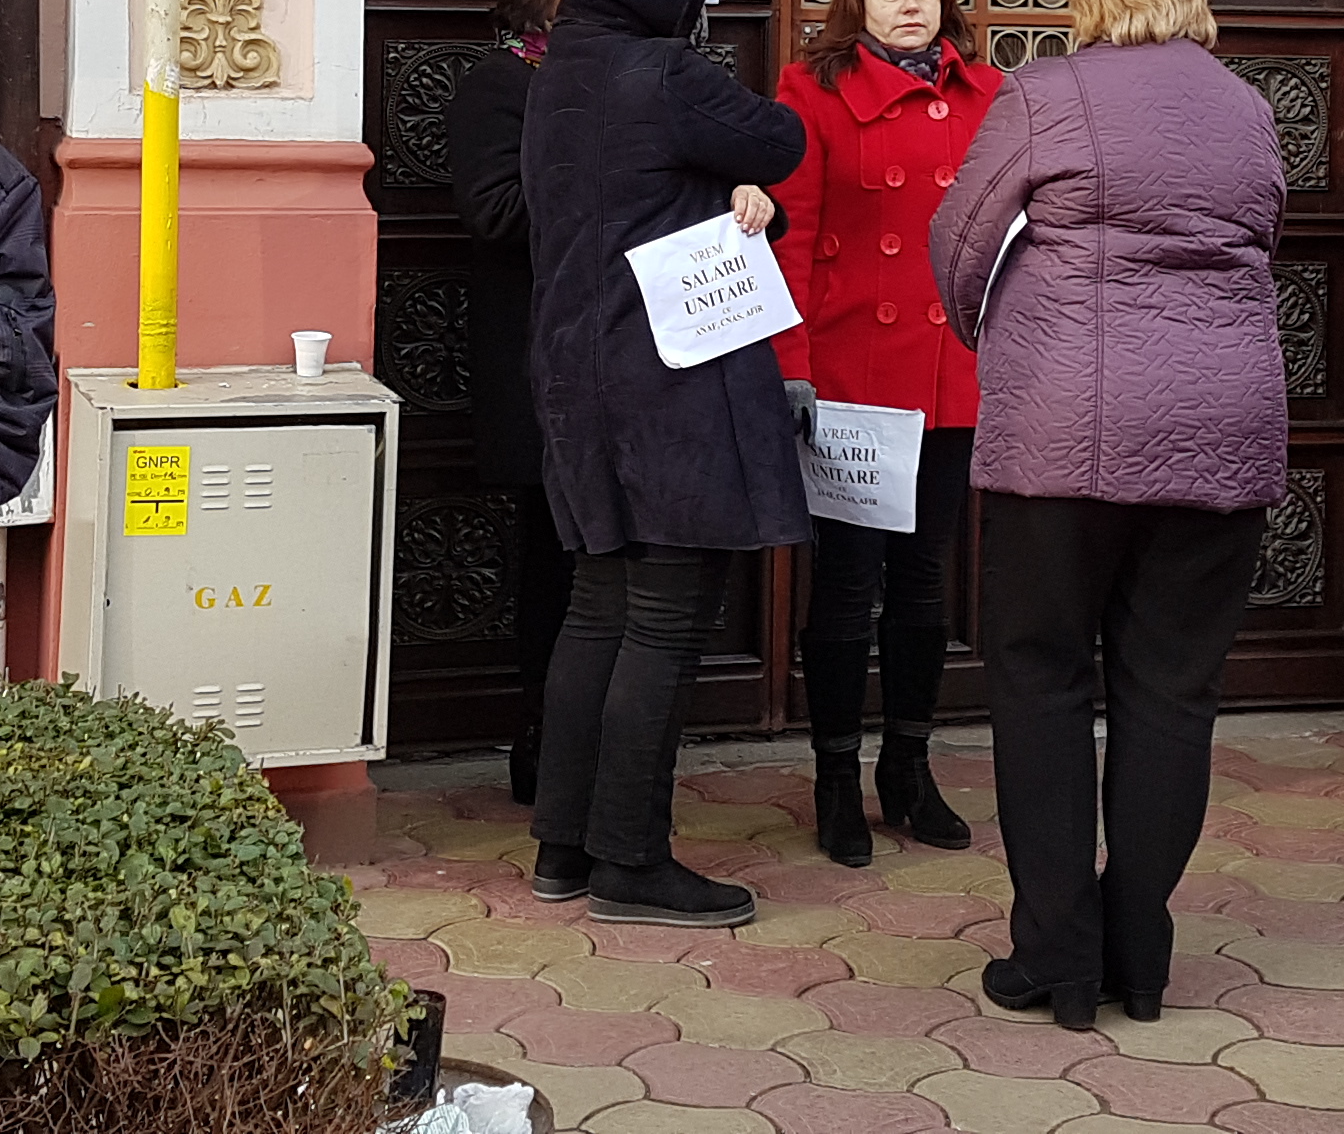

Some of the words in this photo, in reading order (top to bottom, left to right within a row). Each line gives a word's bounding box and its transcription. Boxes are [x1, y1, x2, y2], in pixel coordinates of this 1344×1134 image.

[689, 242, 724, 263] VREM
[681, 254, 747, 292] SALARII
[684, 275, 758, 315] UNITARE
[821, 428, 859, 441] VREM
[136, 456, 181, 469] GNPR
[810, 445, 876, 463] SALARII
[810, 462, 880, 485] UNITARE
[194, 584, 272, 610] GAZ
